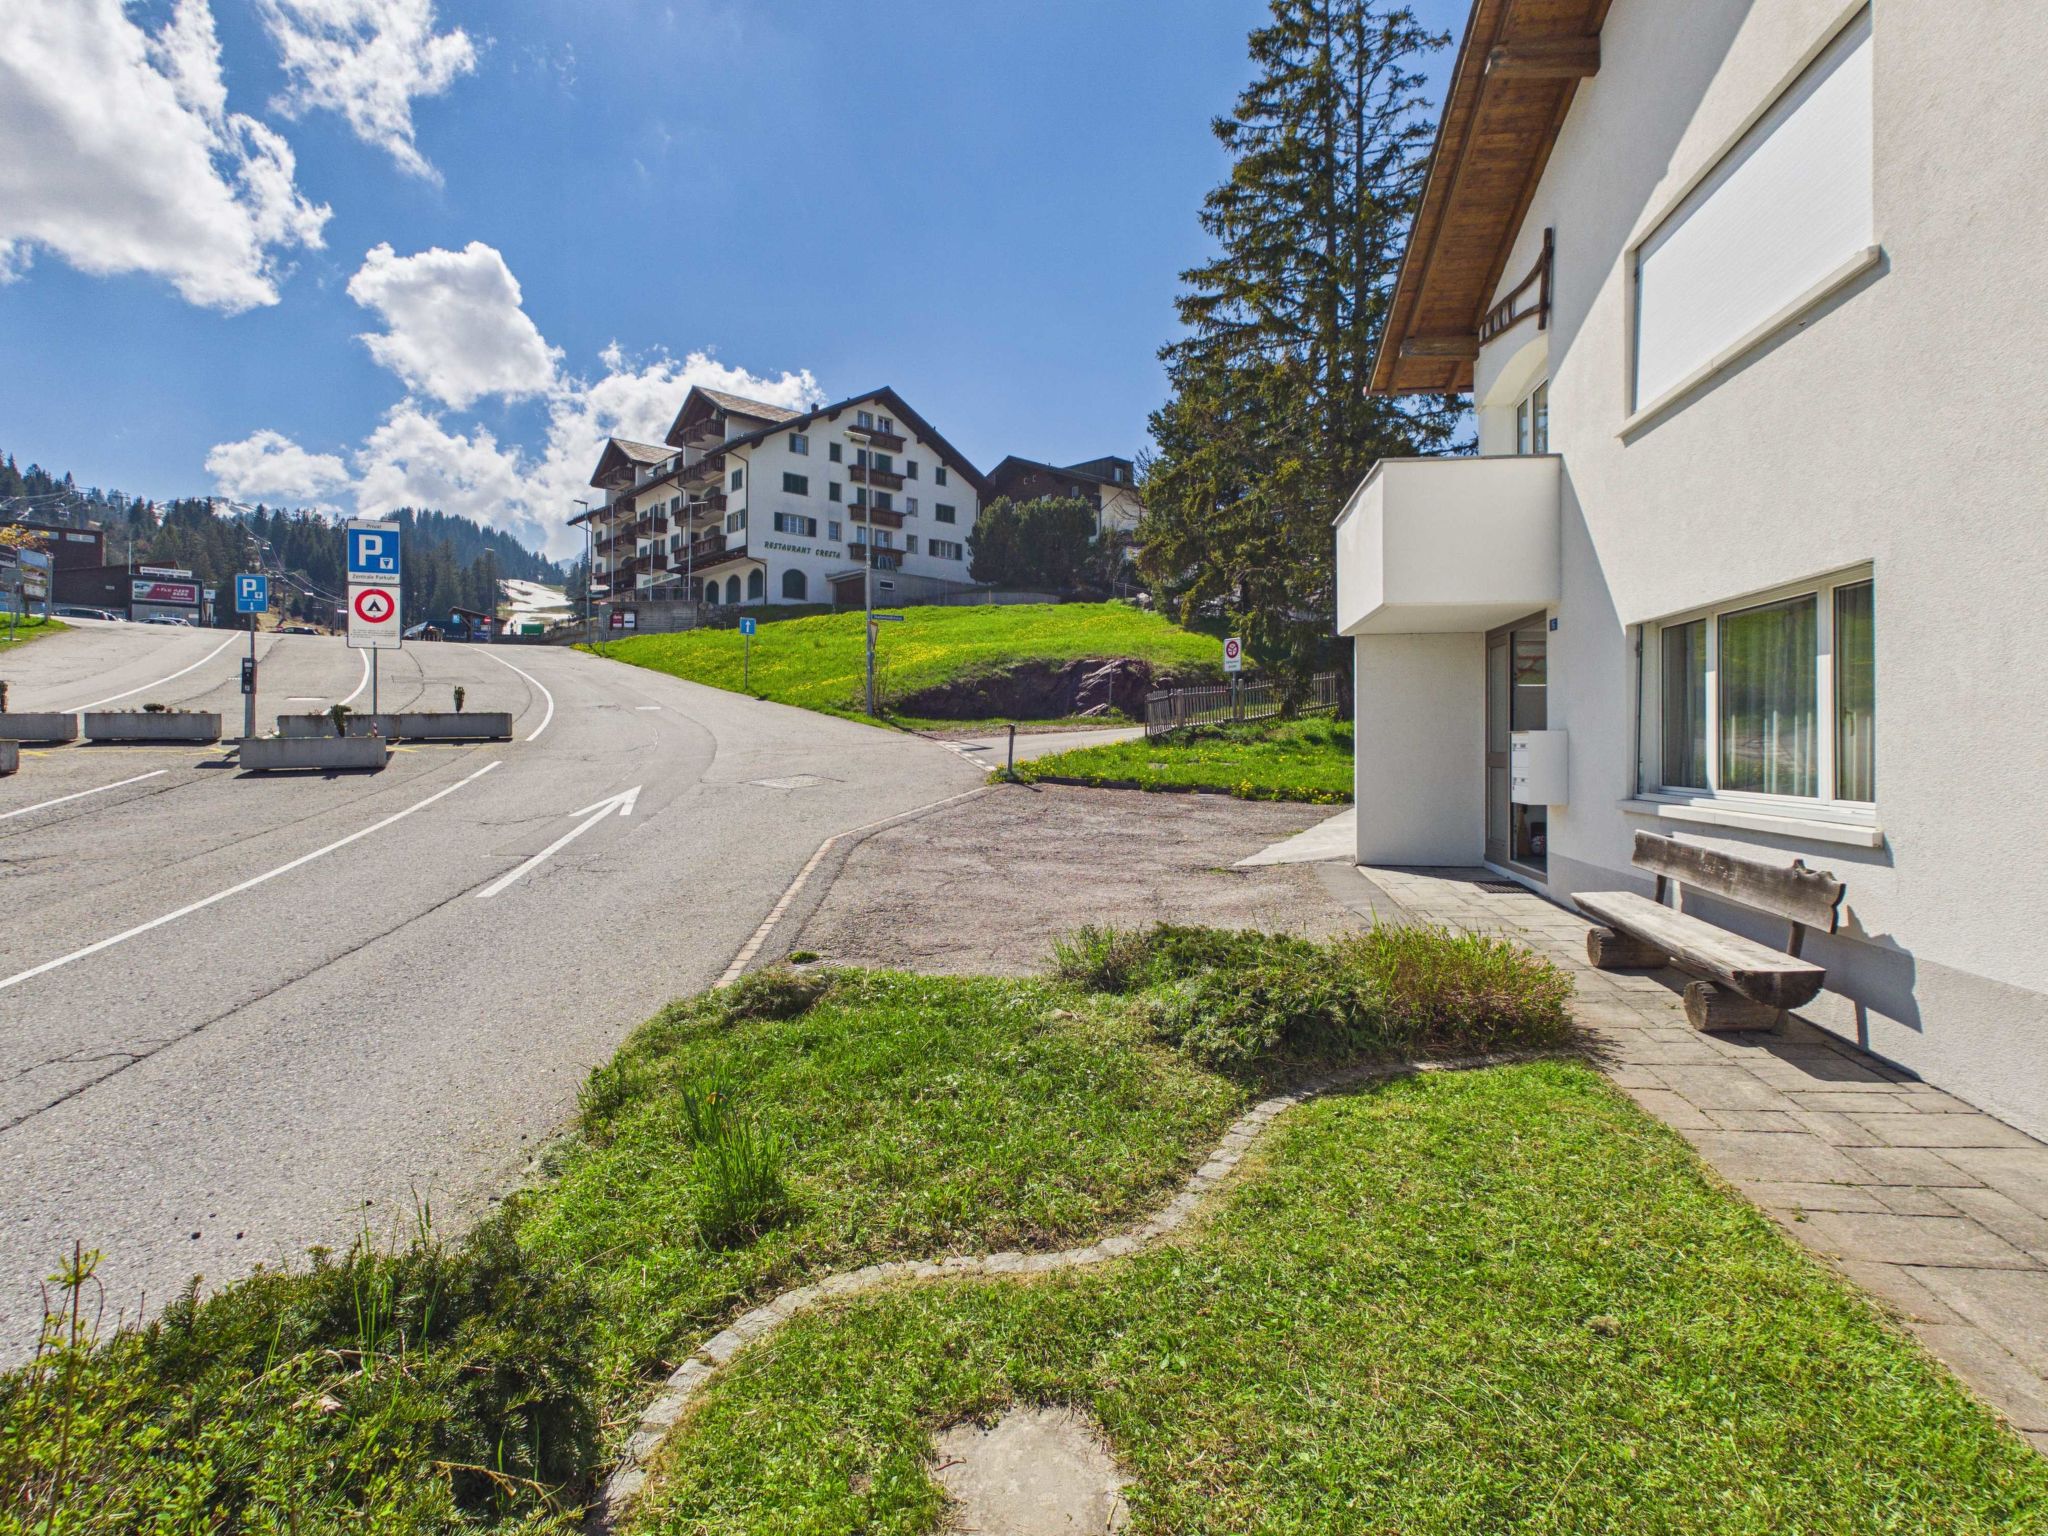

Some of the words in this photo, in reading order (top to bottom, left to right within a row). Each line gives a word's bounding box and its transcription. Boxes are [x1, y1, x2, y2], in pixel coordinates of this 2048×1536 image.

[359, 535, 383, 566] P
[765, 541, 811, 554] RESTAURANT
[816, 549, 841, 559] CRESTA
[243, 579, 257, 597] P
